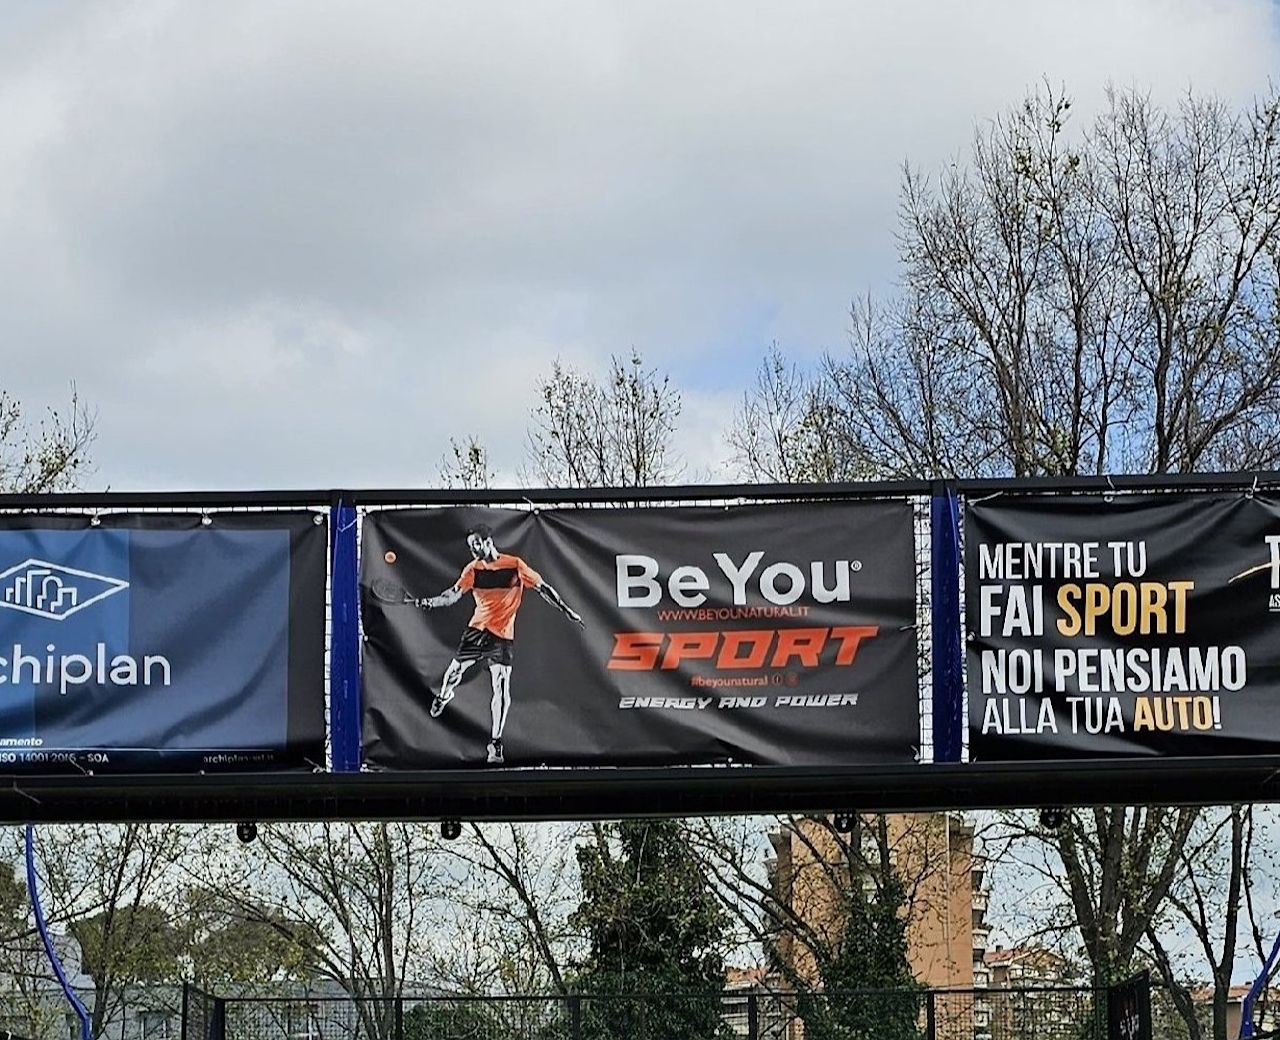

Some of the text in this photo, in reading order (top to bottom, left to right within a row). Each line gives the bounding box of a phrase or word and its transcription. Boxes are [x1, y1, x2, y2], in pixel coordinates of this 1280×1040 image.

[979, 541, 1147, 579] MENTRE TU
[980, 581, 1195, 637] FAI SPORT
[607, 626, 879, 670] SPORT
[981, 645, 1247, 694] NOI PENSIAMO
[619, 693, 859, 709] ENERGY AND POWER
[981, 696, 1222, 735] ALLA TUA AUTO!
